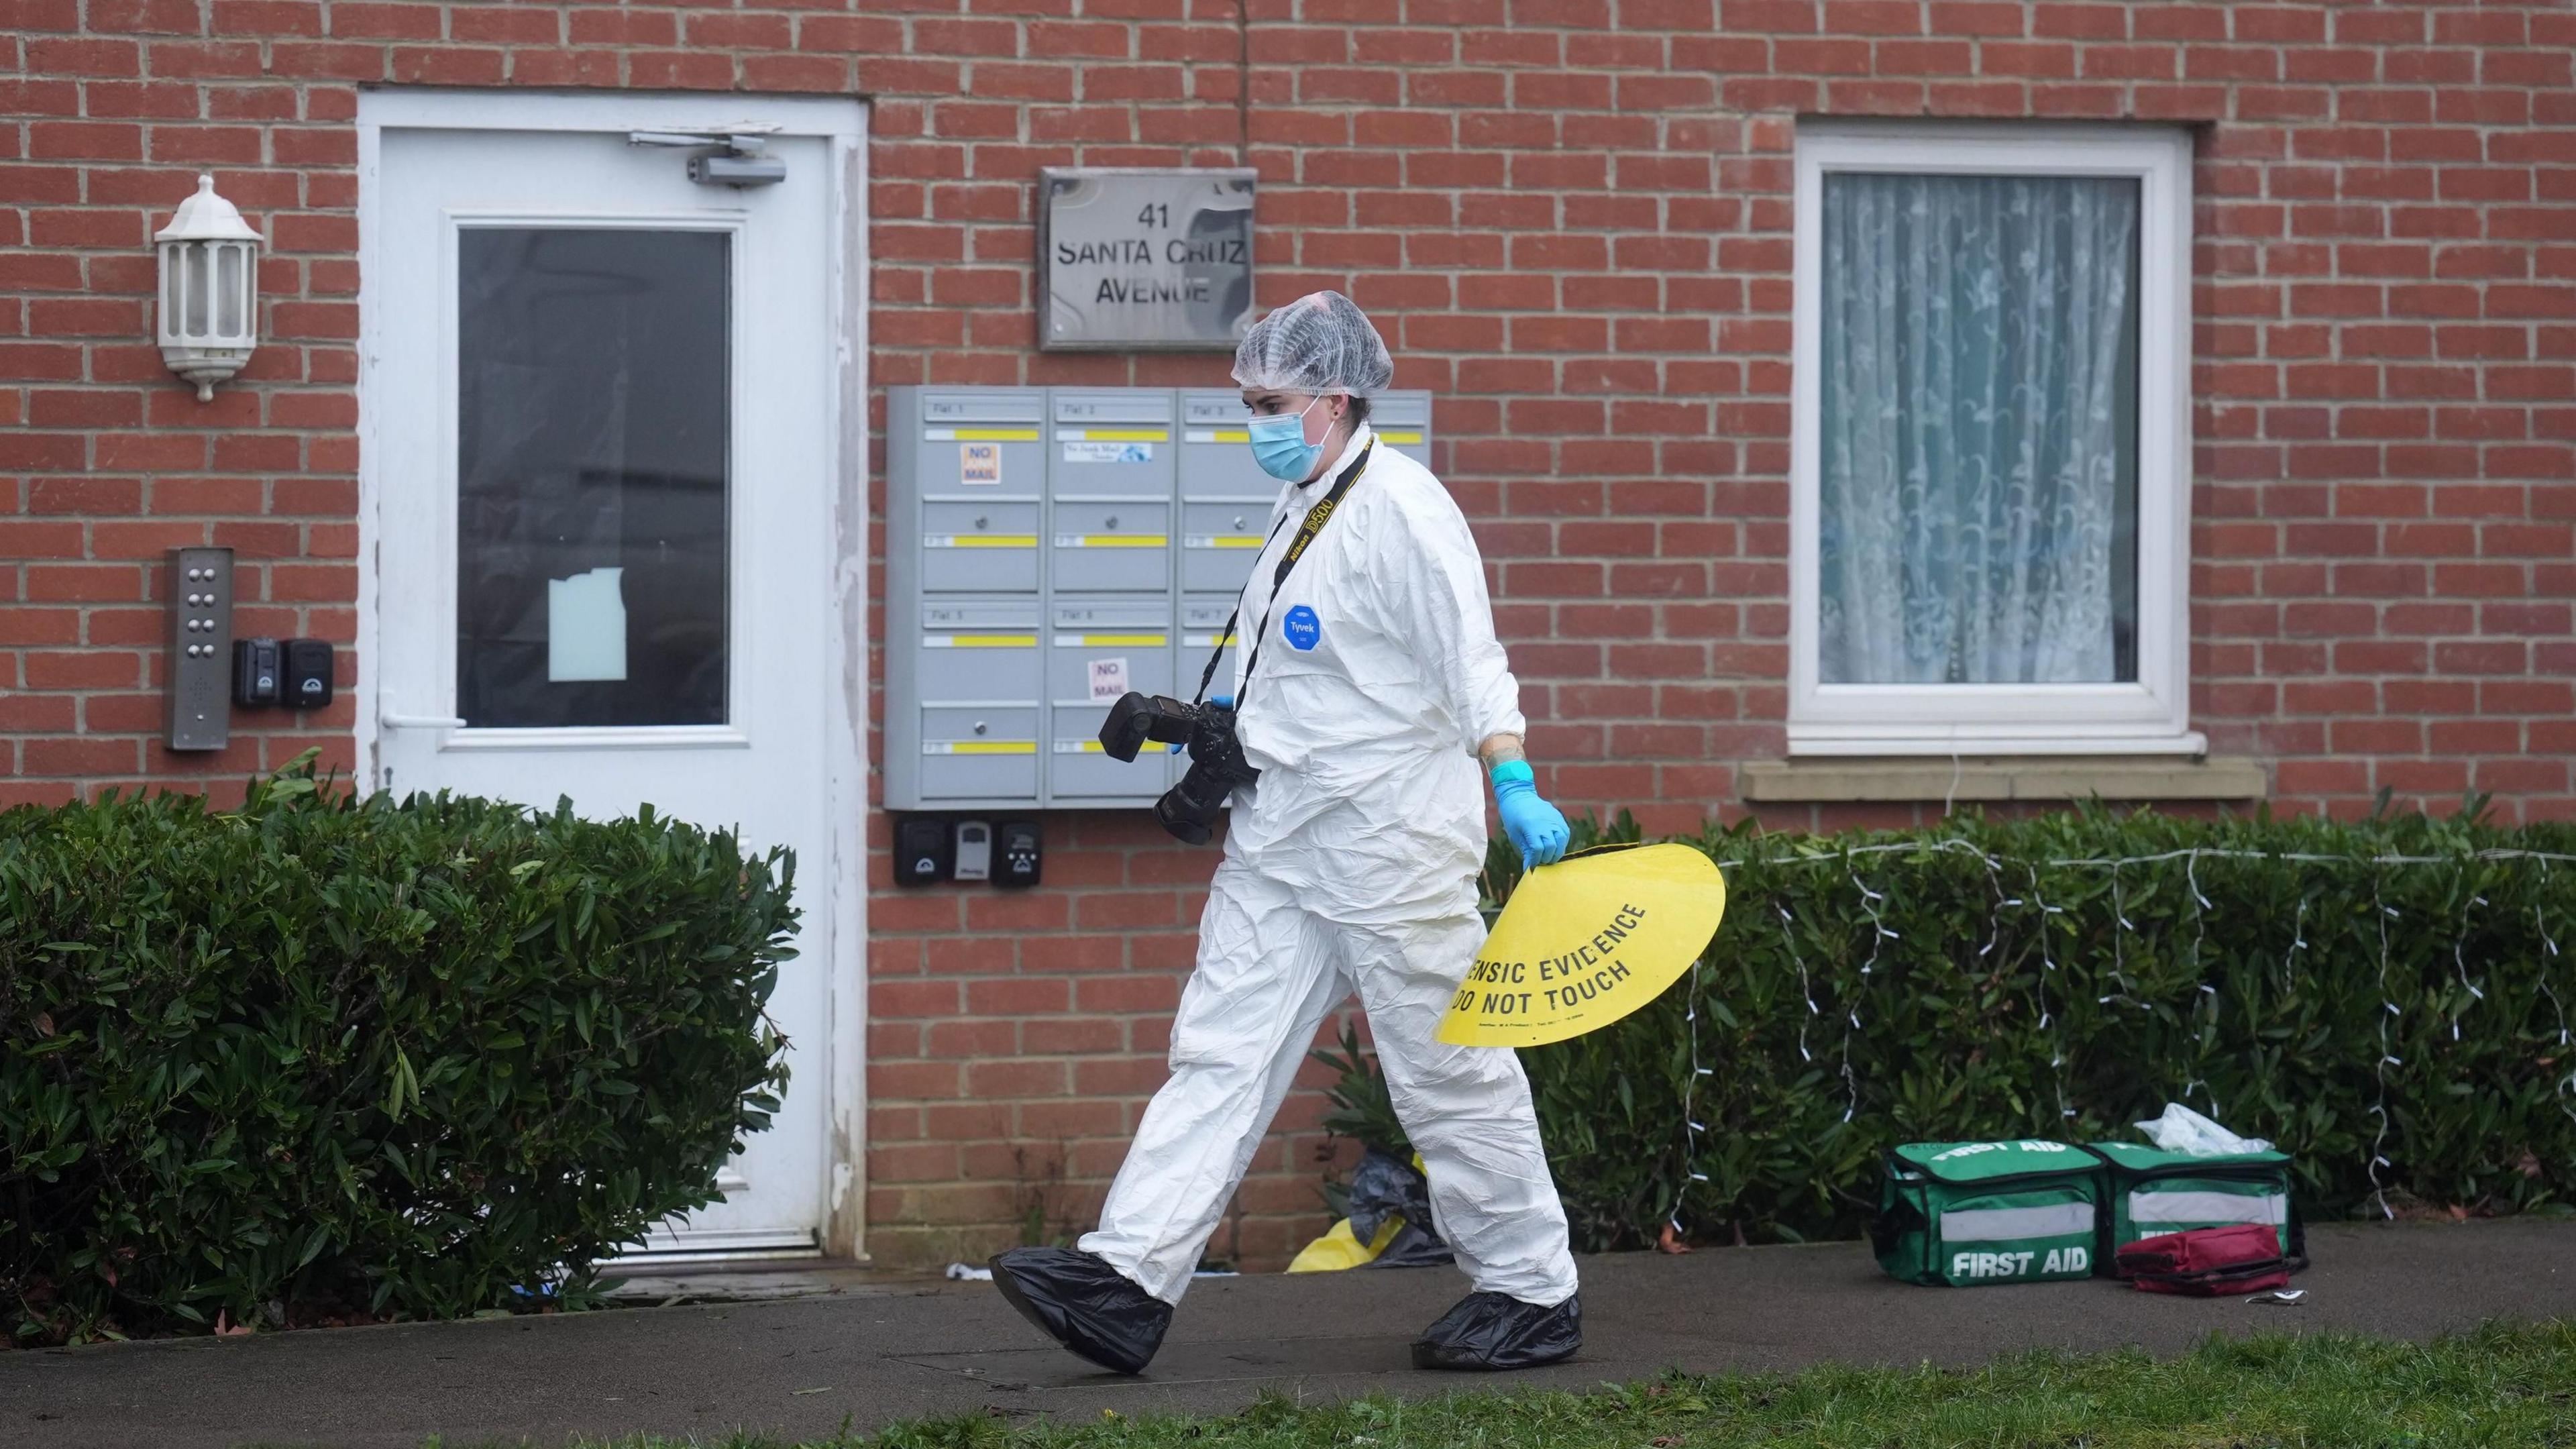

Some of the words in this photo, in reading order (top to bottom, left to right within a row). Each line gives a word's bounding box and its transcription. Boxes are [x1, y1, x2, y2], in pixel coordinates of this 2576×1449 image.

[1138, 203, 1167, 229] 41
[1057, 239, 1152, 264] SANTA
[1167, 239, 1246, 264] CRUZ
[1096, 278, 1210, 303] AVENUE
[933, 403, 951, 413] Flat
[958, 404, 963, 413] 1
[1065, 404, 1081, 414] Flat
[969, 447, 991, 459] NO
[965, 470, 996, 481] MAIL
[1290, 534, 1309, 562] Nikon
[1306, 499, 1334, 534] D500
[1290, 621, 1314, 633] Tyvek
[1097, 663, 1119, 676] NO
[1094, 686, 1124, 698] MAIL
[1481, 993, 1532, 1014] NOT
[1544, 959, 1631, 1011] TOUCH
[1931, 1142, 2008, 1161] FIRST
[2019, 1140, 2067, 1152] AID
[1953, 1251, 2035, 1277] FIRST
[2041, 1246, 2088, 1274] AID
